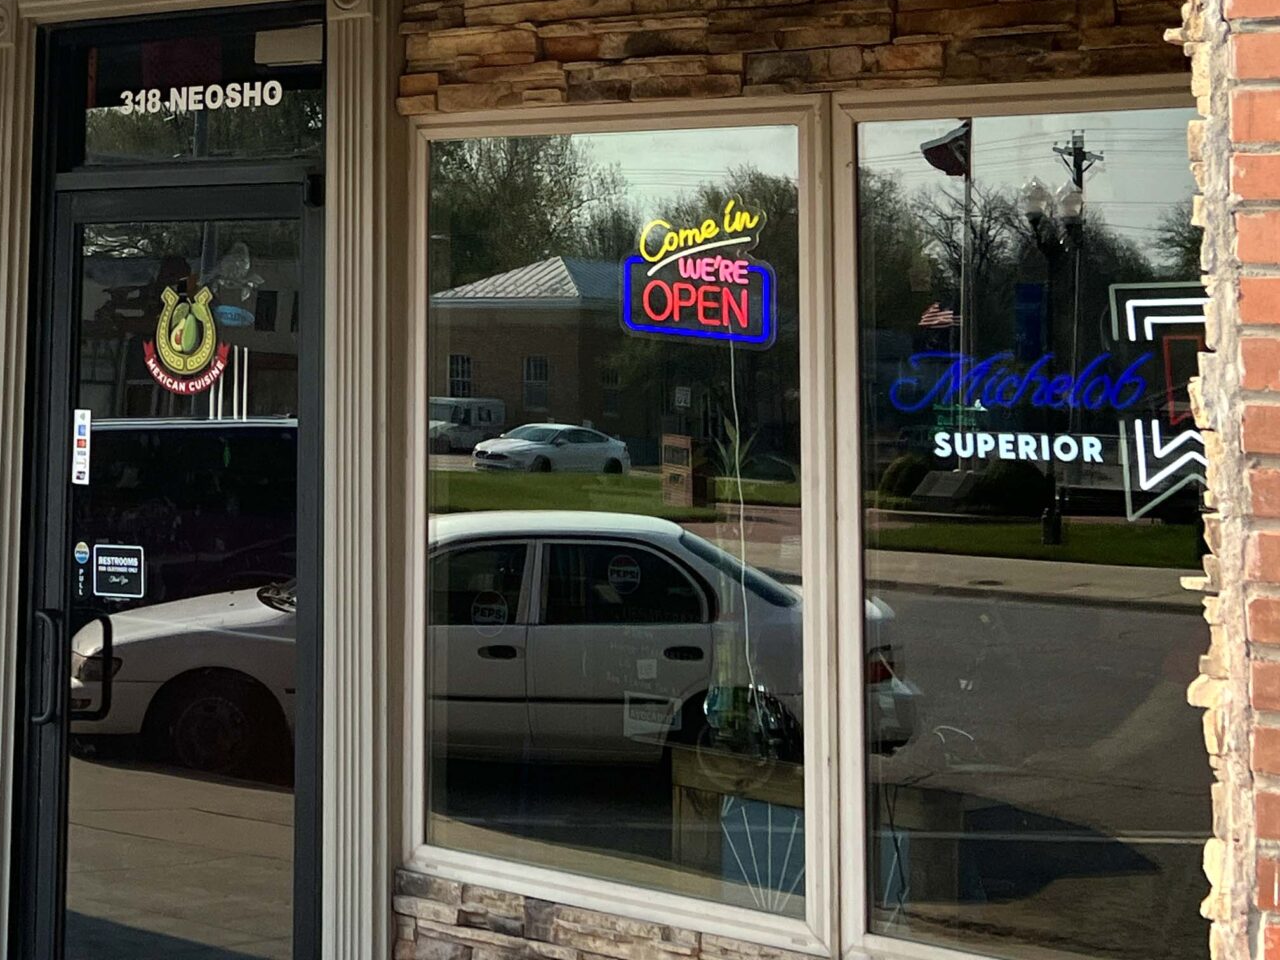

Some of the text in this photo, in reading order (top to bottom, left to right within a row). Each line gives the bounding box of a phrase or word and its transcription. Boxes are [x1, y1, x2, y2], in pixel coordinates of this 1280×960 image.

[120, 80, 284, 115] 318 NEOSHO
[640, 219, 719, 262] Come
[678, 255, 749, 284] WE'RE
[642, 279, 748, 328] OPEN
[146, 358, 225, 392] MEXICAN CUISINE
[889, 351, 1155, 413] Michelob
[934, 431, 1104, 464] SUPERIOR
[98, 556, 138, 566] RESTROOMS
[609, 568, 638, 580] PEPSI
[473, 606, 505, 619] PEPSI
